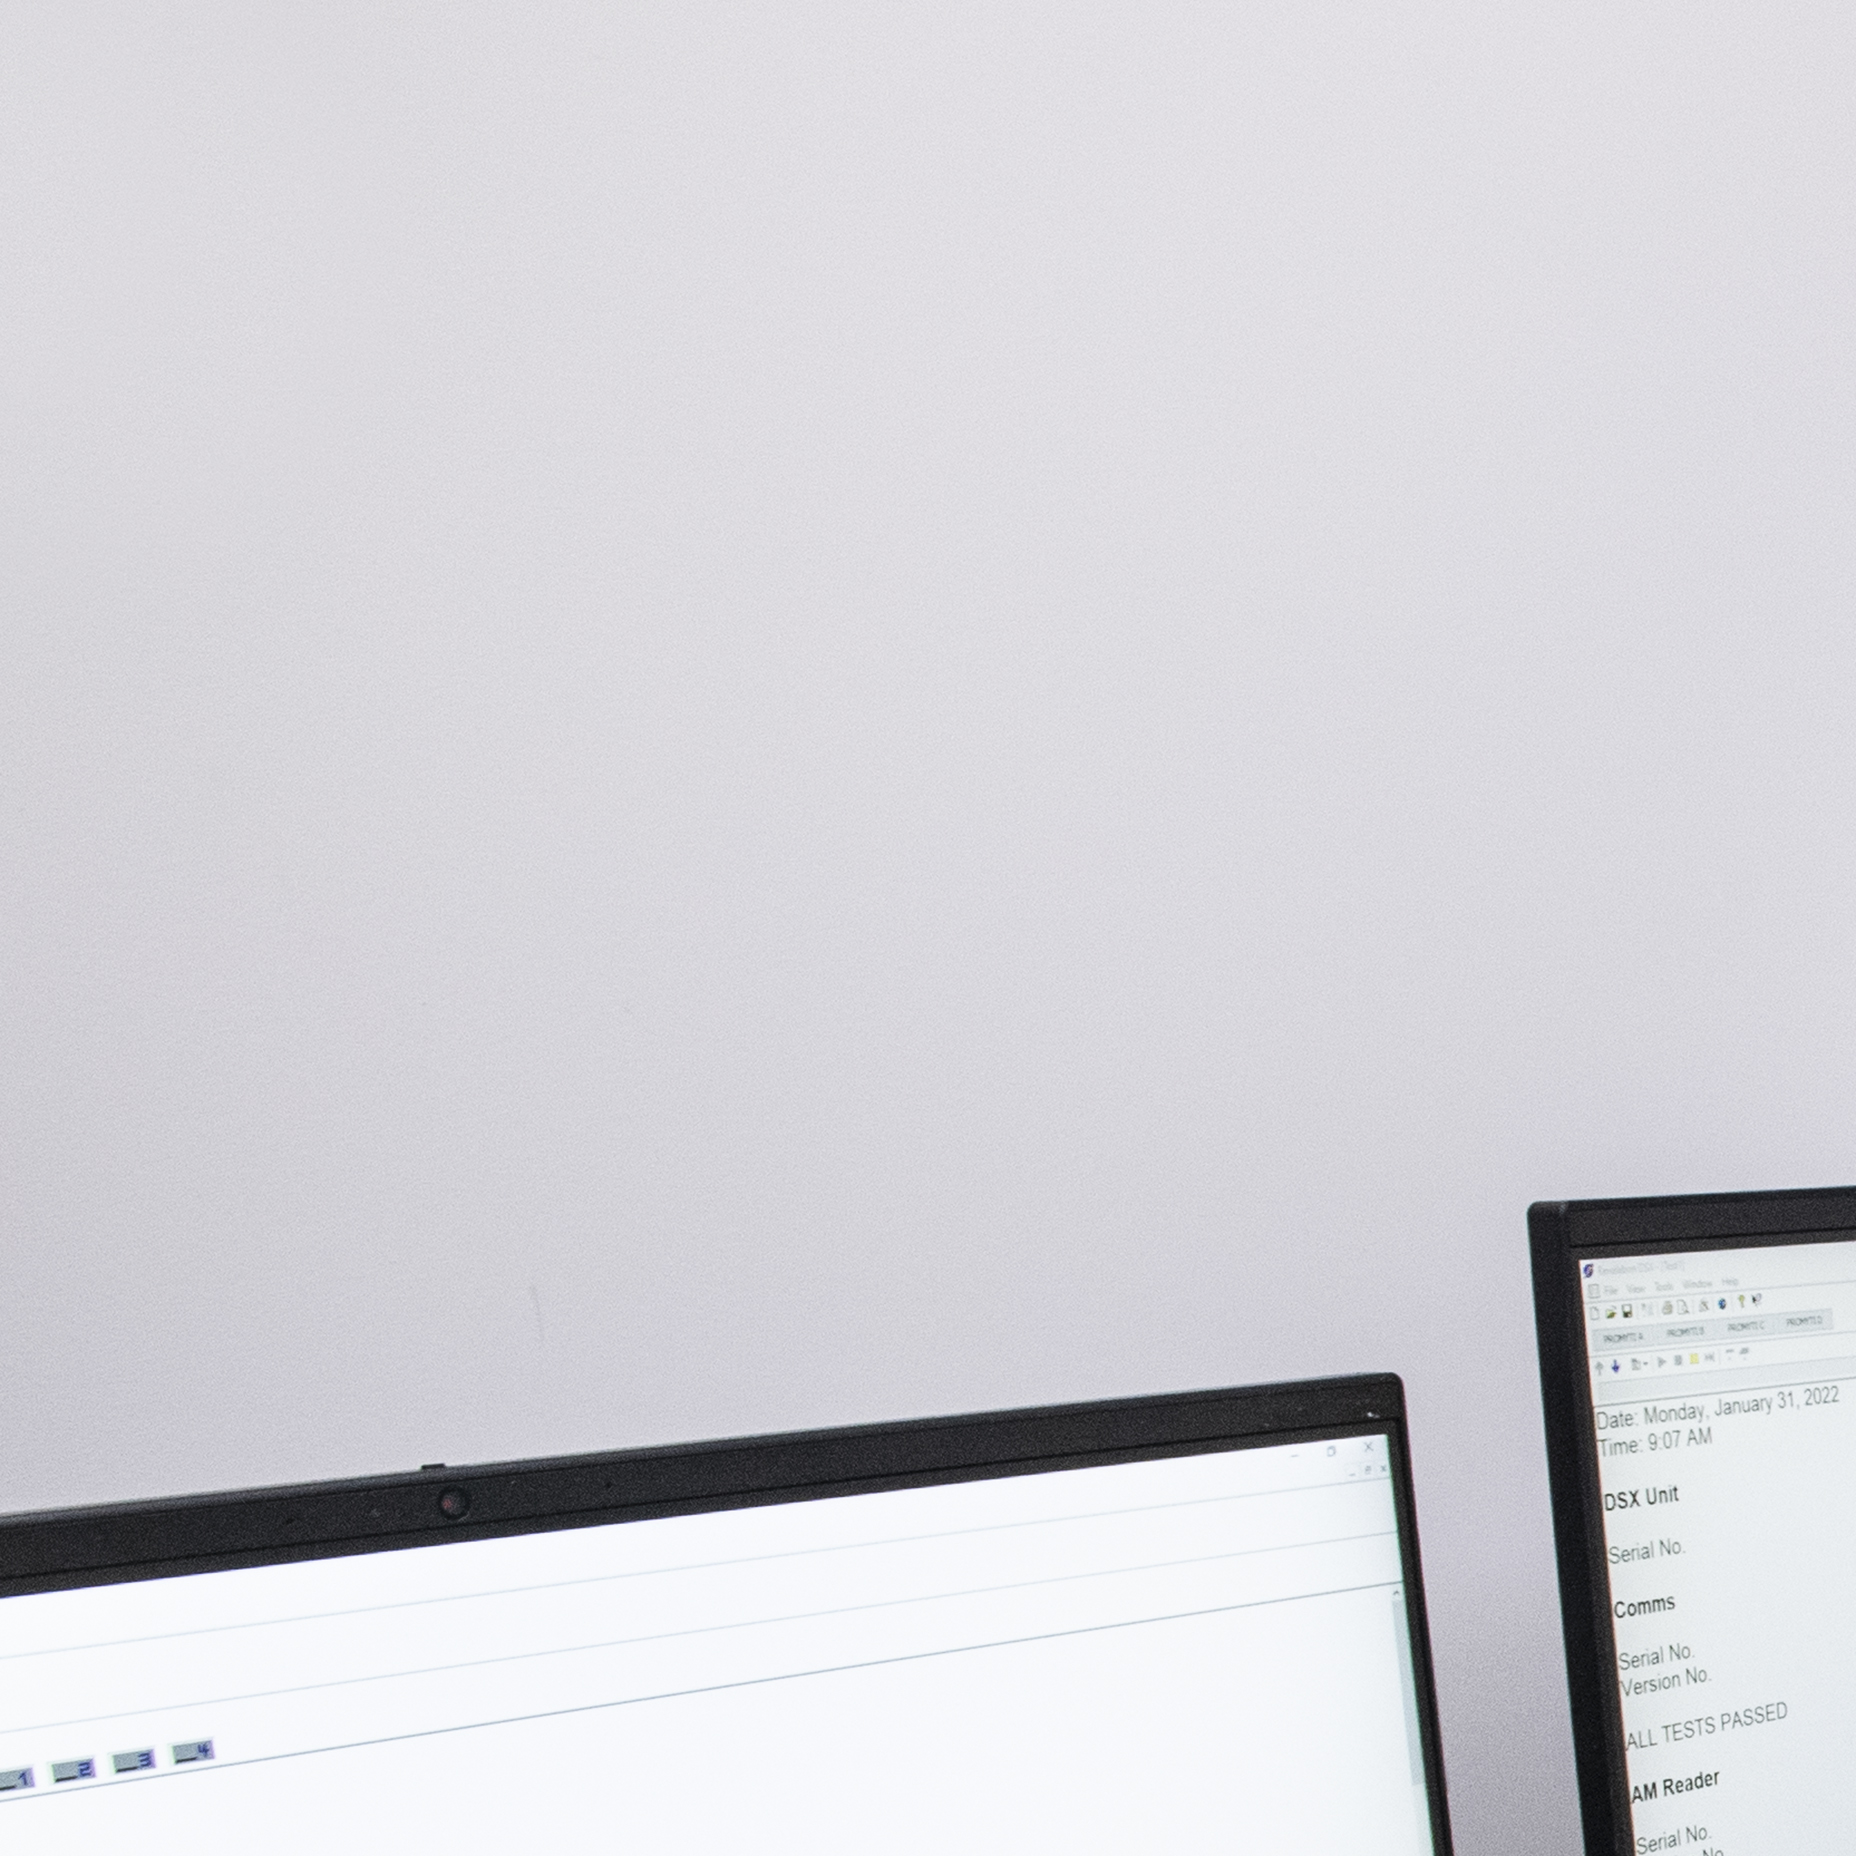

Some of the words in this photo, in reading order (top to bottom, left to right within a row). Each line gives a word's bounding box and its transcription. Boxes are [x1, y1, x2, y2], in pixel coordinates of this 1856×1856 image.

[1597, 1412, 1638, 1430] Date:
[1644, 1404, 1709, 1425] Monday,
[1714, 1394, 1772, 1416] January
[1778, 1391, 1800, 1410] 31,
[1805, 1386, 1839, 1406] 2022
[1598, 1438, 1642, 1457] Time:
[1648, 1430, 1681, 1452] 9:07
[1687, 1427, 1713, 1447] AM
[1604, 1490, 1640, 1511] DSX
[1646, 1485, 1679, 1504] Unit
[1608, 1541, 1655, 1564] Serial
[1659, 1538, 1686, 1557] No.
[1614, 1596, 1675, 1619] Comms
[1619, 1646, 1664, 1671] Serial
[1669, 1643, 1695, 1662] No.
[1620, 1673, 1681, 1697] Version
[1686, 1667, 1712, 1686] No.
[1626, 1729, 1657, 1750] ALL
[1662, 1716, 1716, 1743] TESTS
[1721, 1701, 1788, 1731] PASSED
[1632, 1782, 1657, 1804] AM
[1663, 1771, 1720, 1797] Reader
[1636, 1829, 1681, 1855] Serial
[1686, 1825, 1712, 1843] No.
